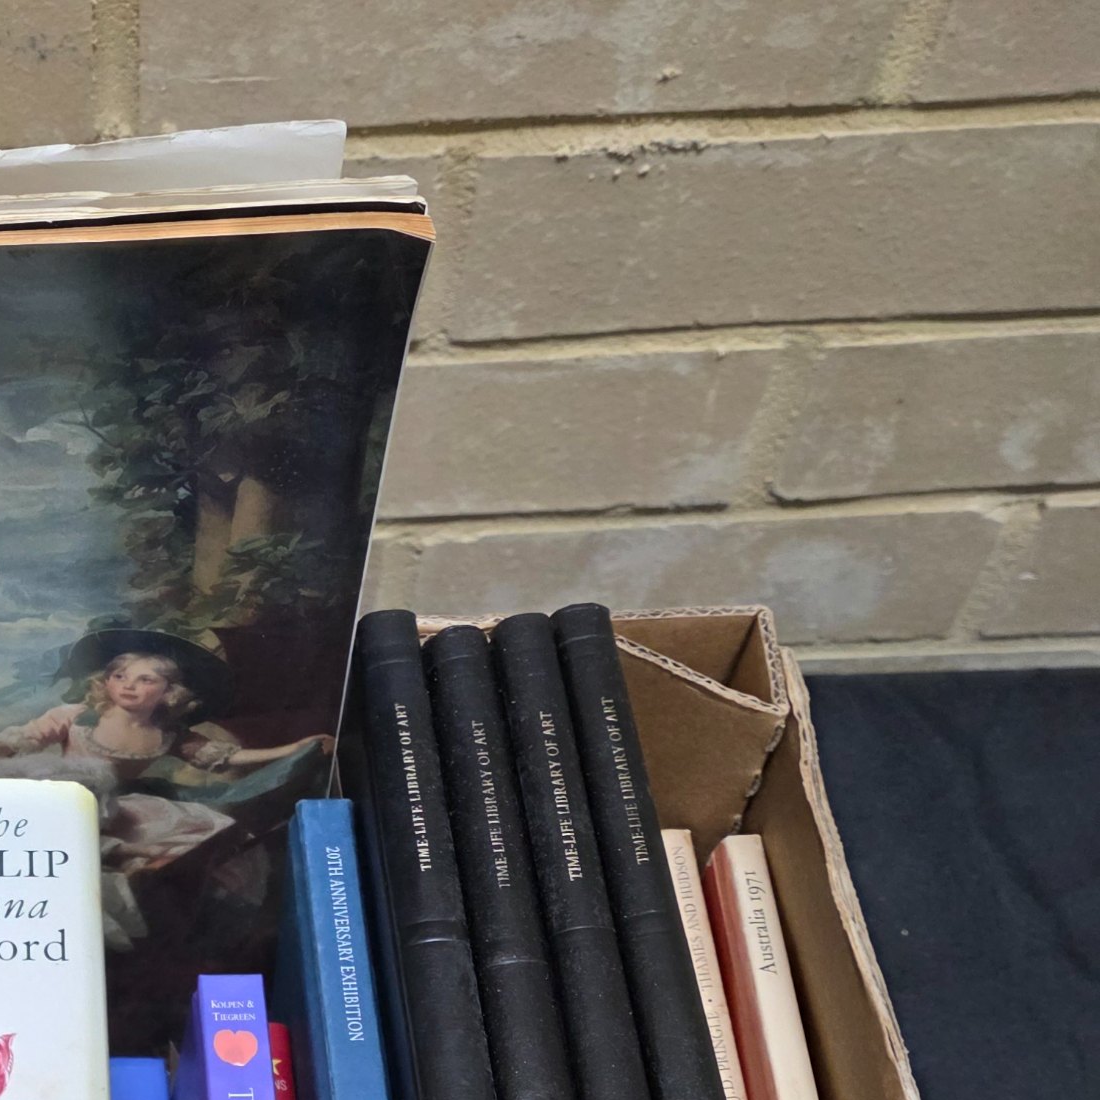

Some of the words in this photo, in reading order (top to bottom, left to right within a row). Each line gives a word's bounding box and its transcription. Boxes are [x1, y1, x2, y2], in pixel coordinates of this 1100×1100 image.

[394, 703, 407, 728] ART
[400, 729, 412, 745] OF
[540, 711, 557, 736] ART
[601, 697, 619, 722] ART
[402, 748, 421, 802] LIBRARY
[547, 739, 560, 756] OF
[615, 745, 636, 801] LIBRARY
[549, 759, 571, 815] LIBRARY
[325, 847, 344, 876] 20TH
[412, 805, 432, 871] TIME-LIFE
[559, 818, 583, 881] TIME-LIFE
[673, 846, 694, 902] HUDSON
[746, 871, 764, 901] 1971
[330, 877, 354, 962] ANNIVERSARY
[685, 903, 701, 931] AND
[748, 907, 778, 975] Australia
[691, 935, 715, 993] THAMES
[341, 965, 364, 1041] EXHIBITION
